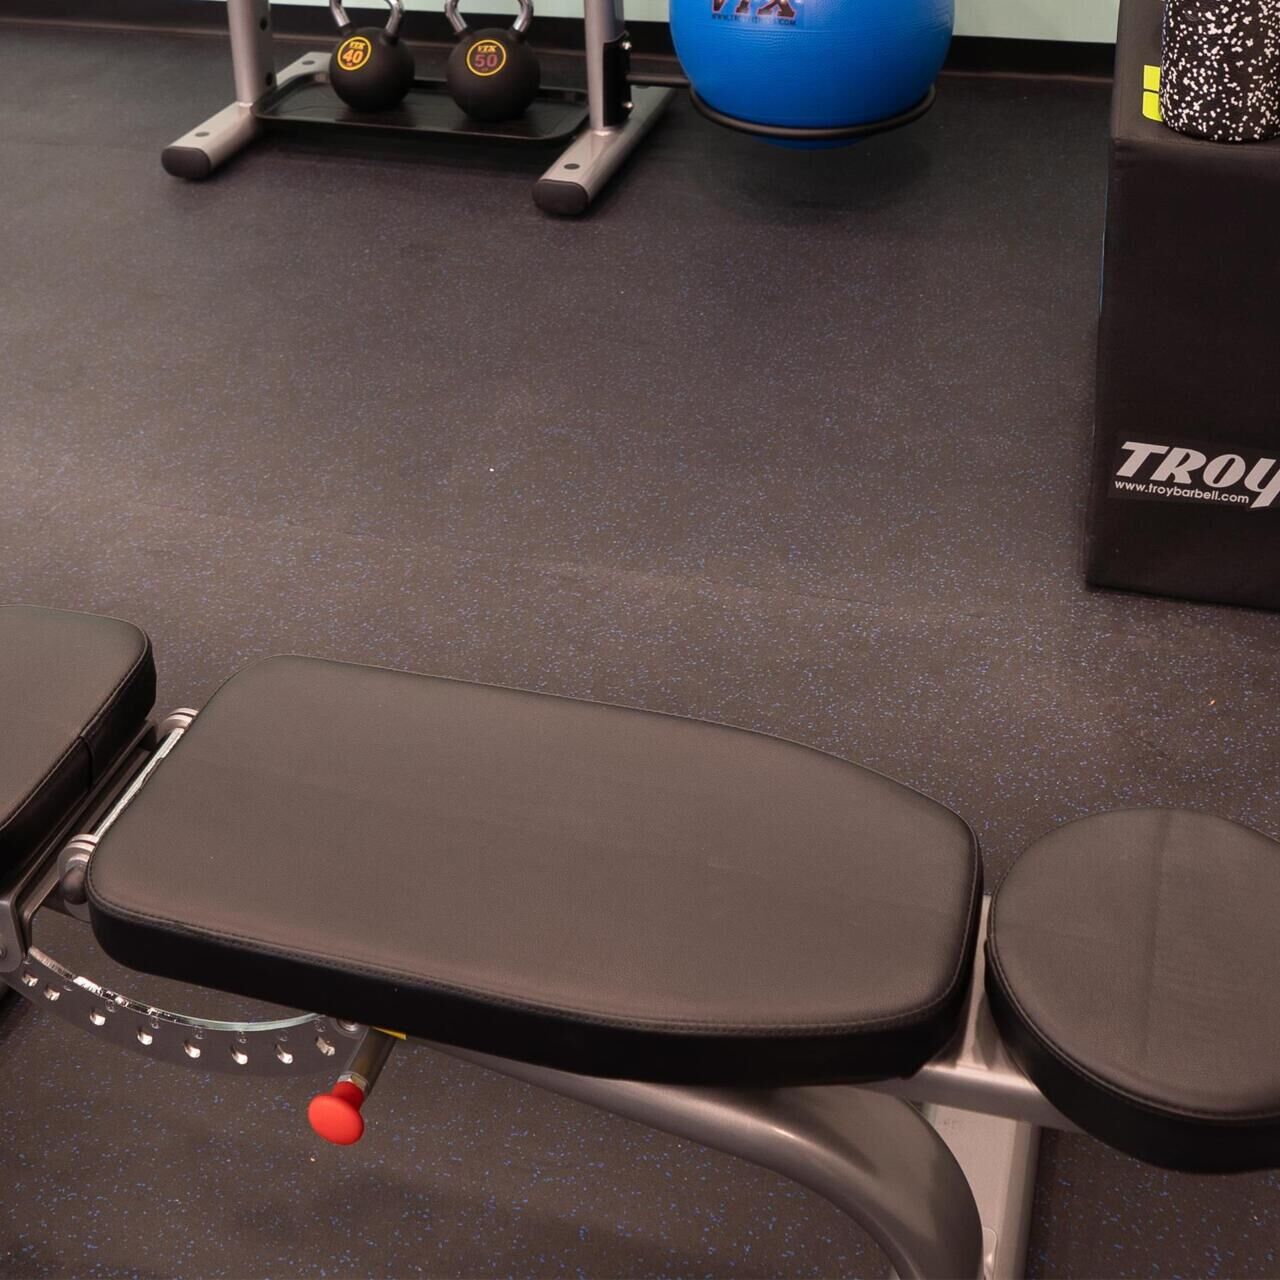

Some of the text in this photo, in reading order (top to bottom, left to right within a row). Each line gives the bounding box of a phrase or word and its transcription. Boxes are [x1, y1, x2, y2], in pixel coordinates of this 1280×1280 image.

[342, 50, 363, 64] 40
[475, 54, 498, 68] 50
[1114, 480, 1250, 504] www.troybarbell.com
